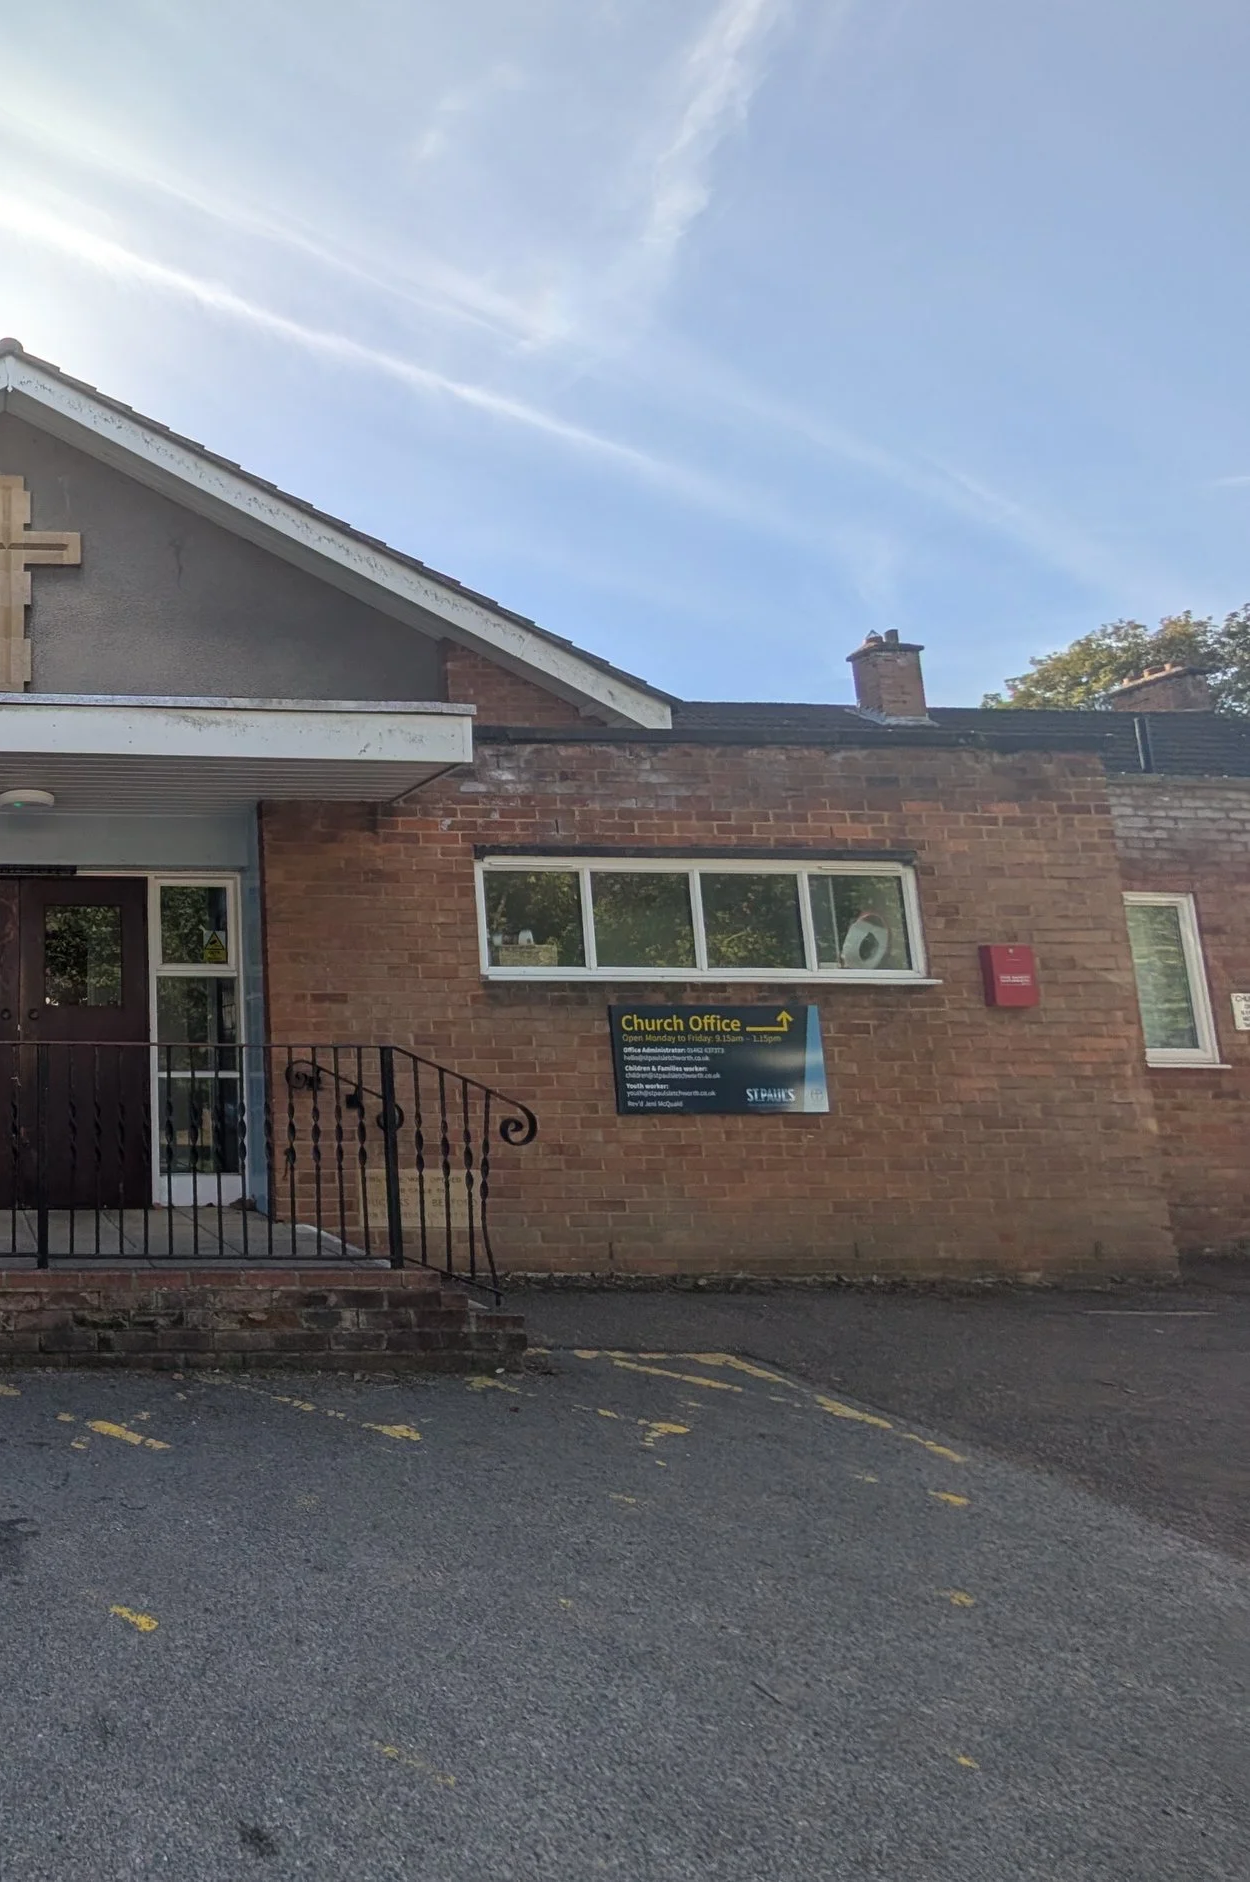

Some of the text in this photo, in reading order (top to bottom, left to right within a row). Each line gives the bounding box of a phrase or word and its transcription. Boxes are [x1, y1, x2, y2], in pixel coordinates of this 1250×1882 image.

[621, 1014, 741, 1032] Church Office
[622, 1035, 643, 1043] Open
[645, 1034, 676, 1043] Monday
[687, 1034, 712, 1043] Friday:
[753, 1035, 782, 1044] 1.15pm
